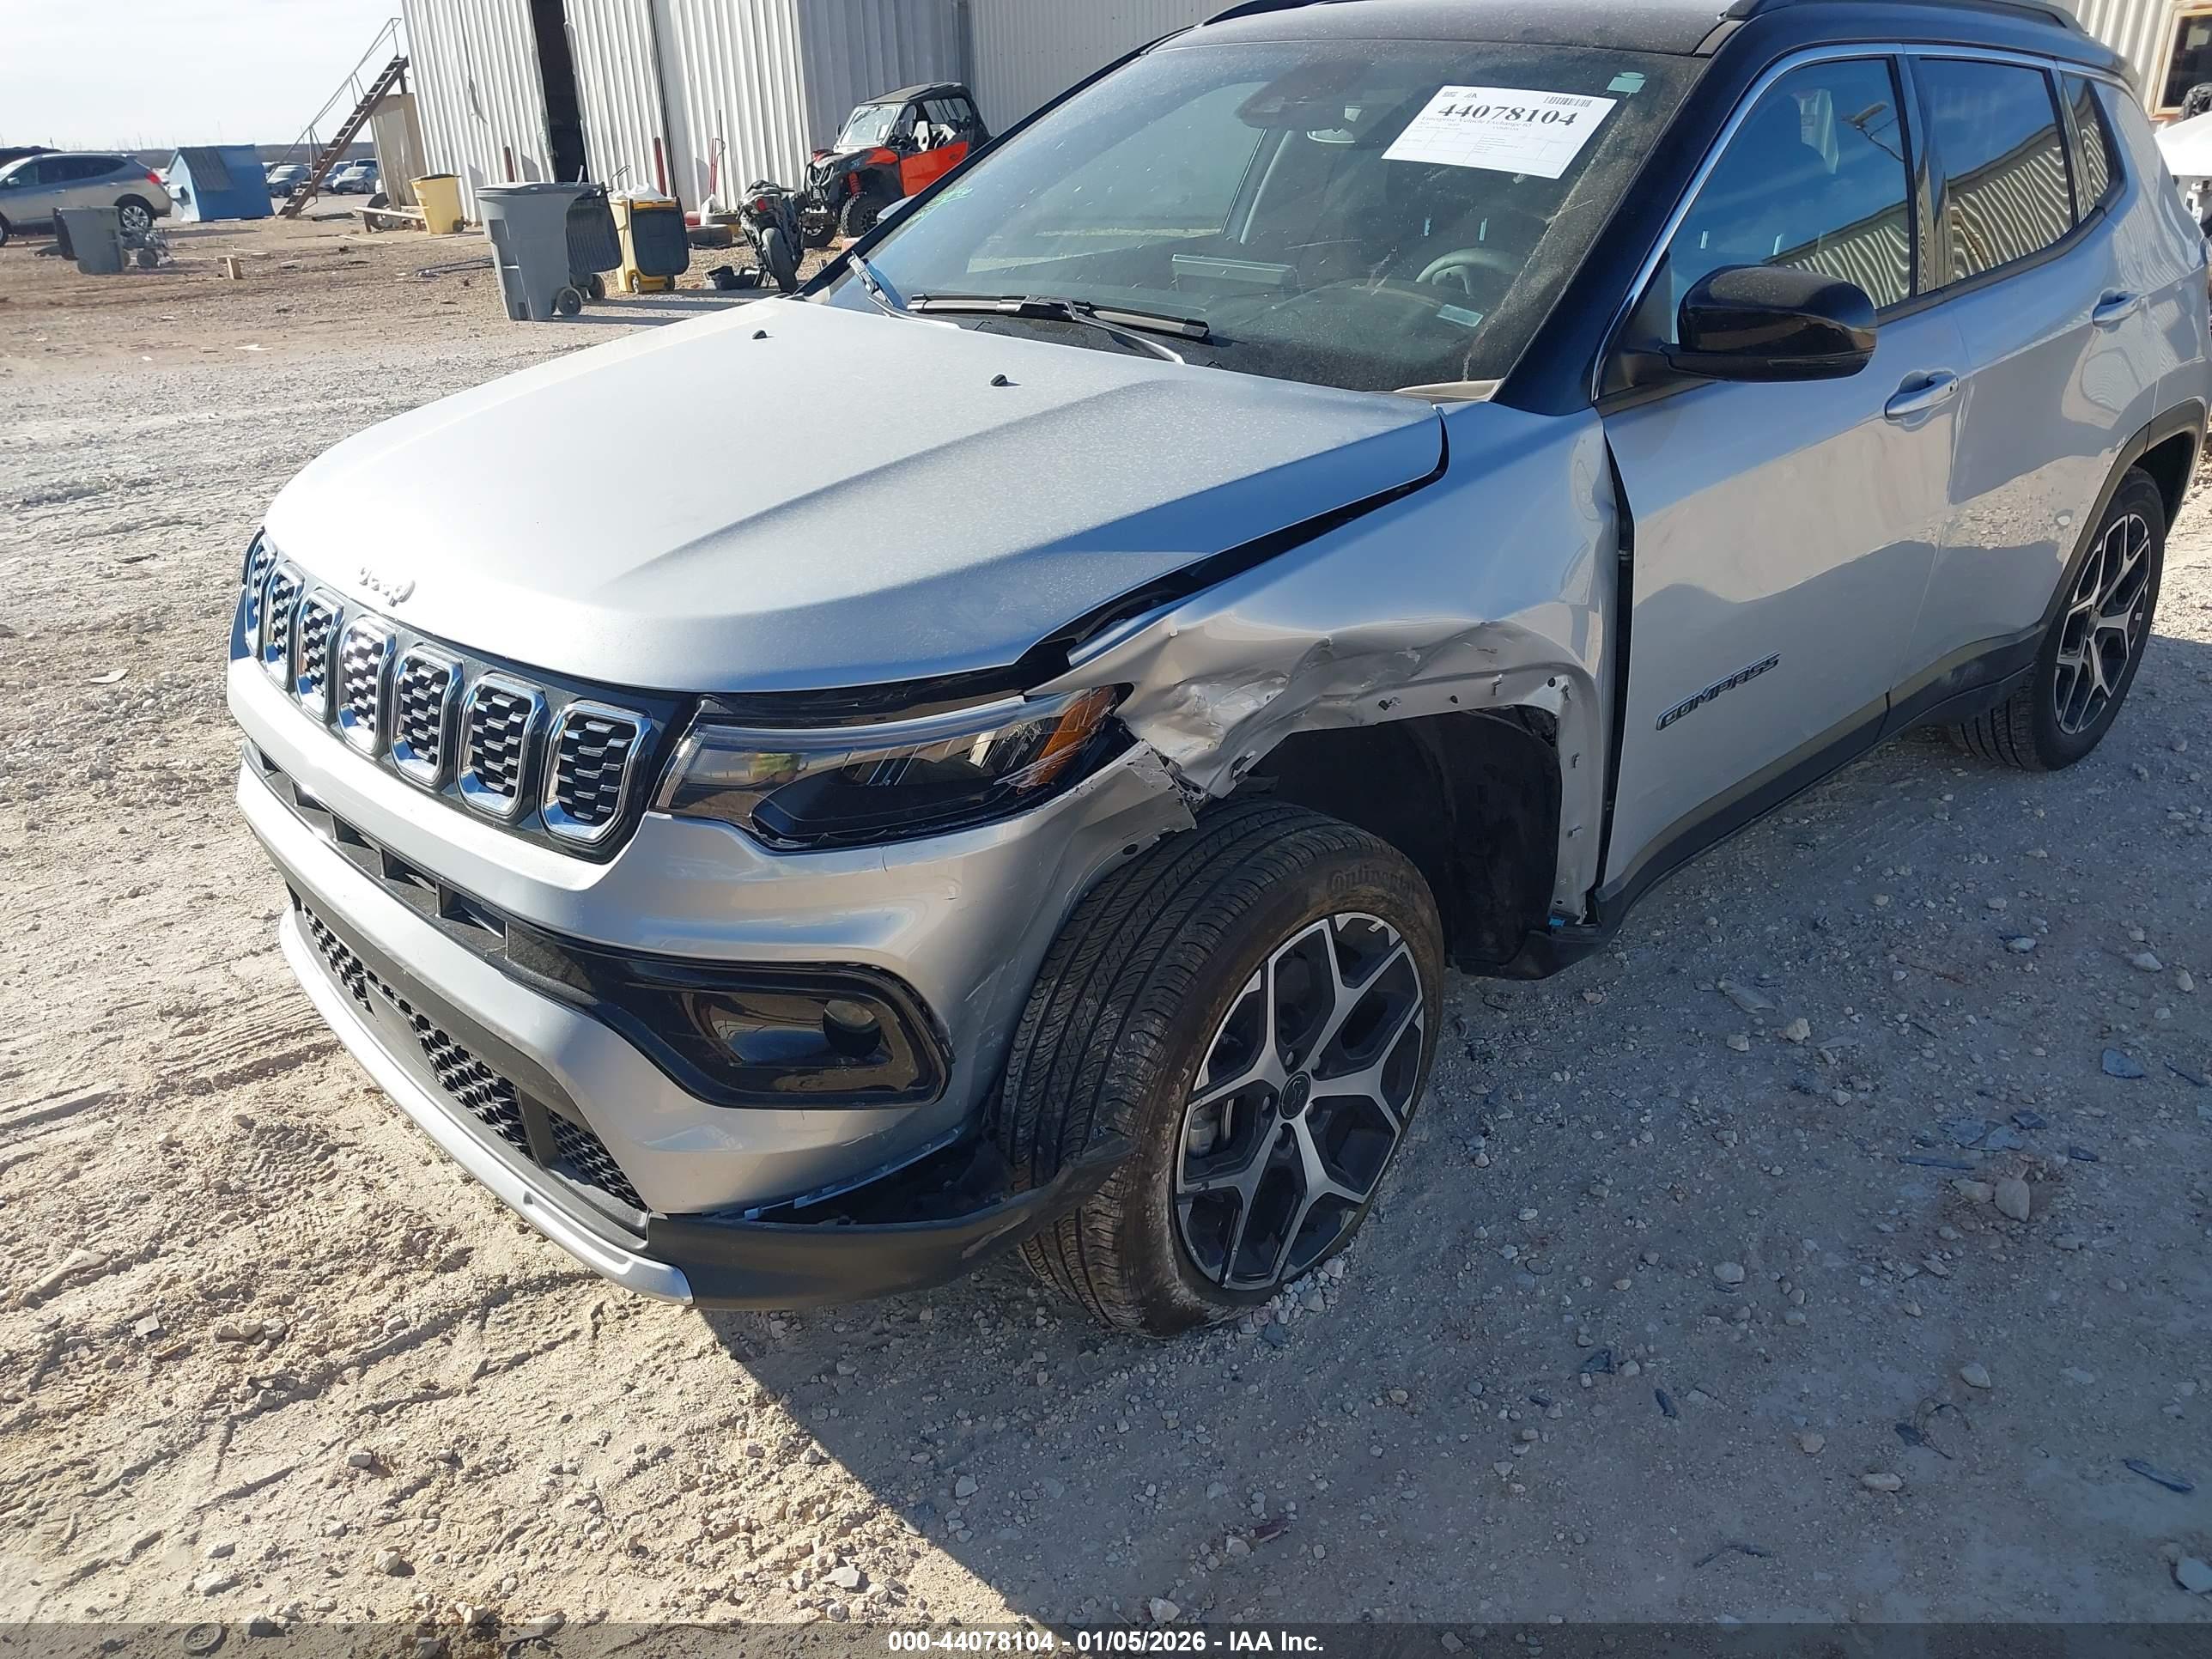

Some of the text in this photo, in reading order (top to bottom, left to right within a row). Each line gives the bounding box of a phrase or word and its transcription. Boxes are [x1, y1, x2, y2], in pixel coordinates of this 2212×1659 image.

[1437, 102, 1579, 126] 44078104
[358, 564, 416, 608] Jeep
[1656, 651, 1781, 731] COMPASS
